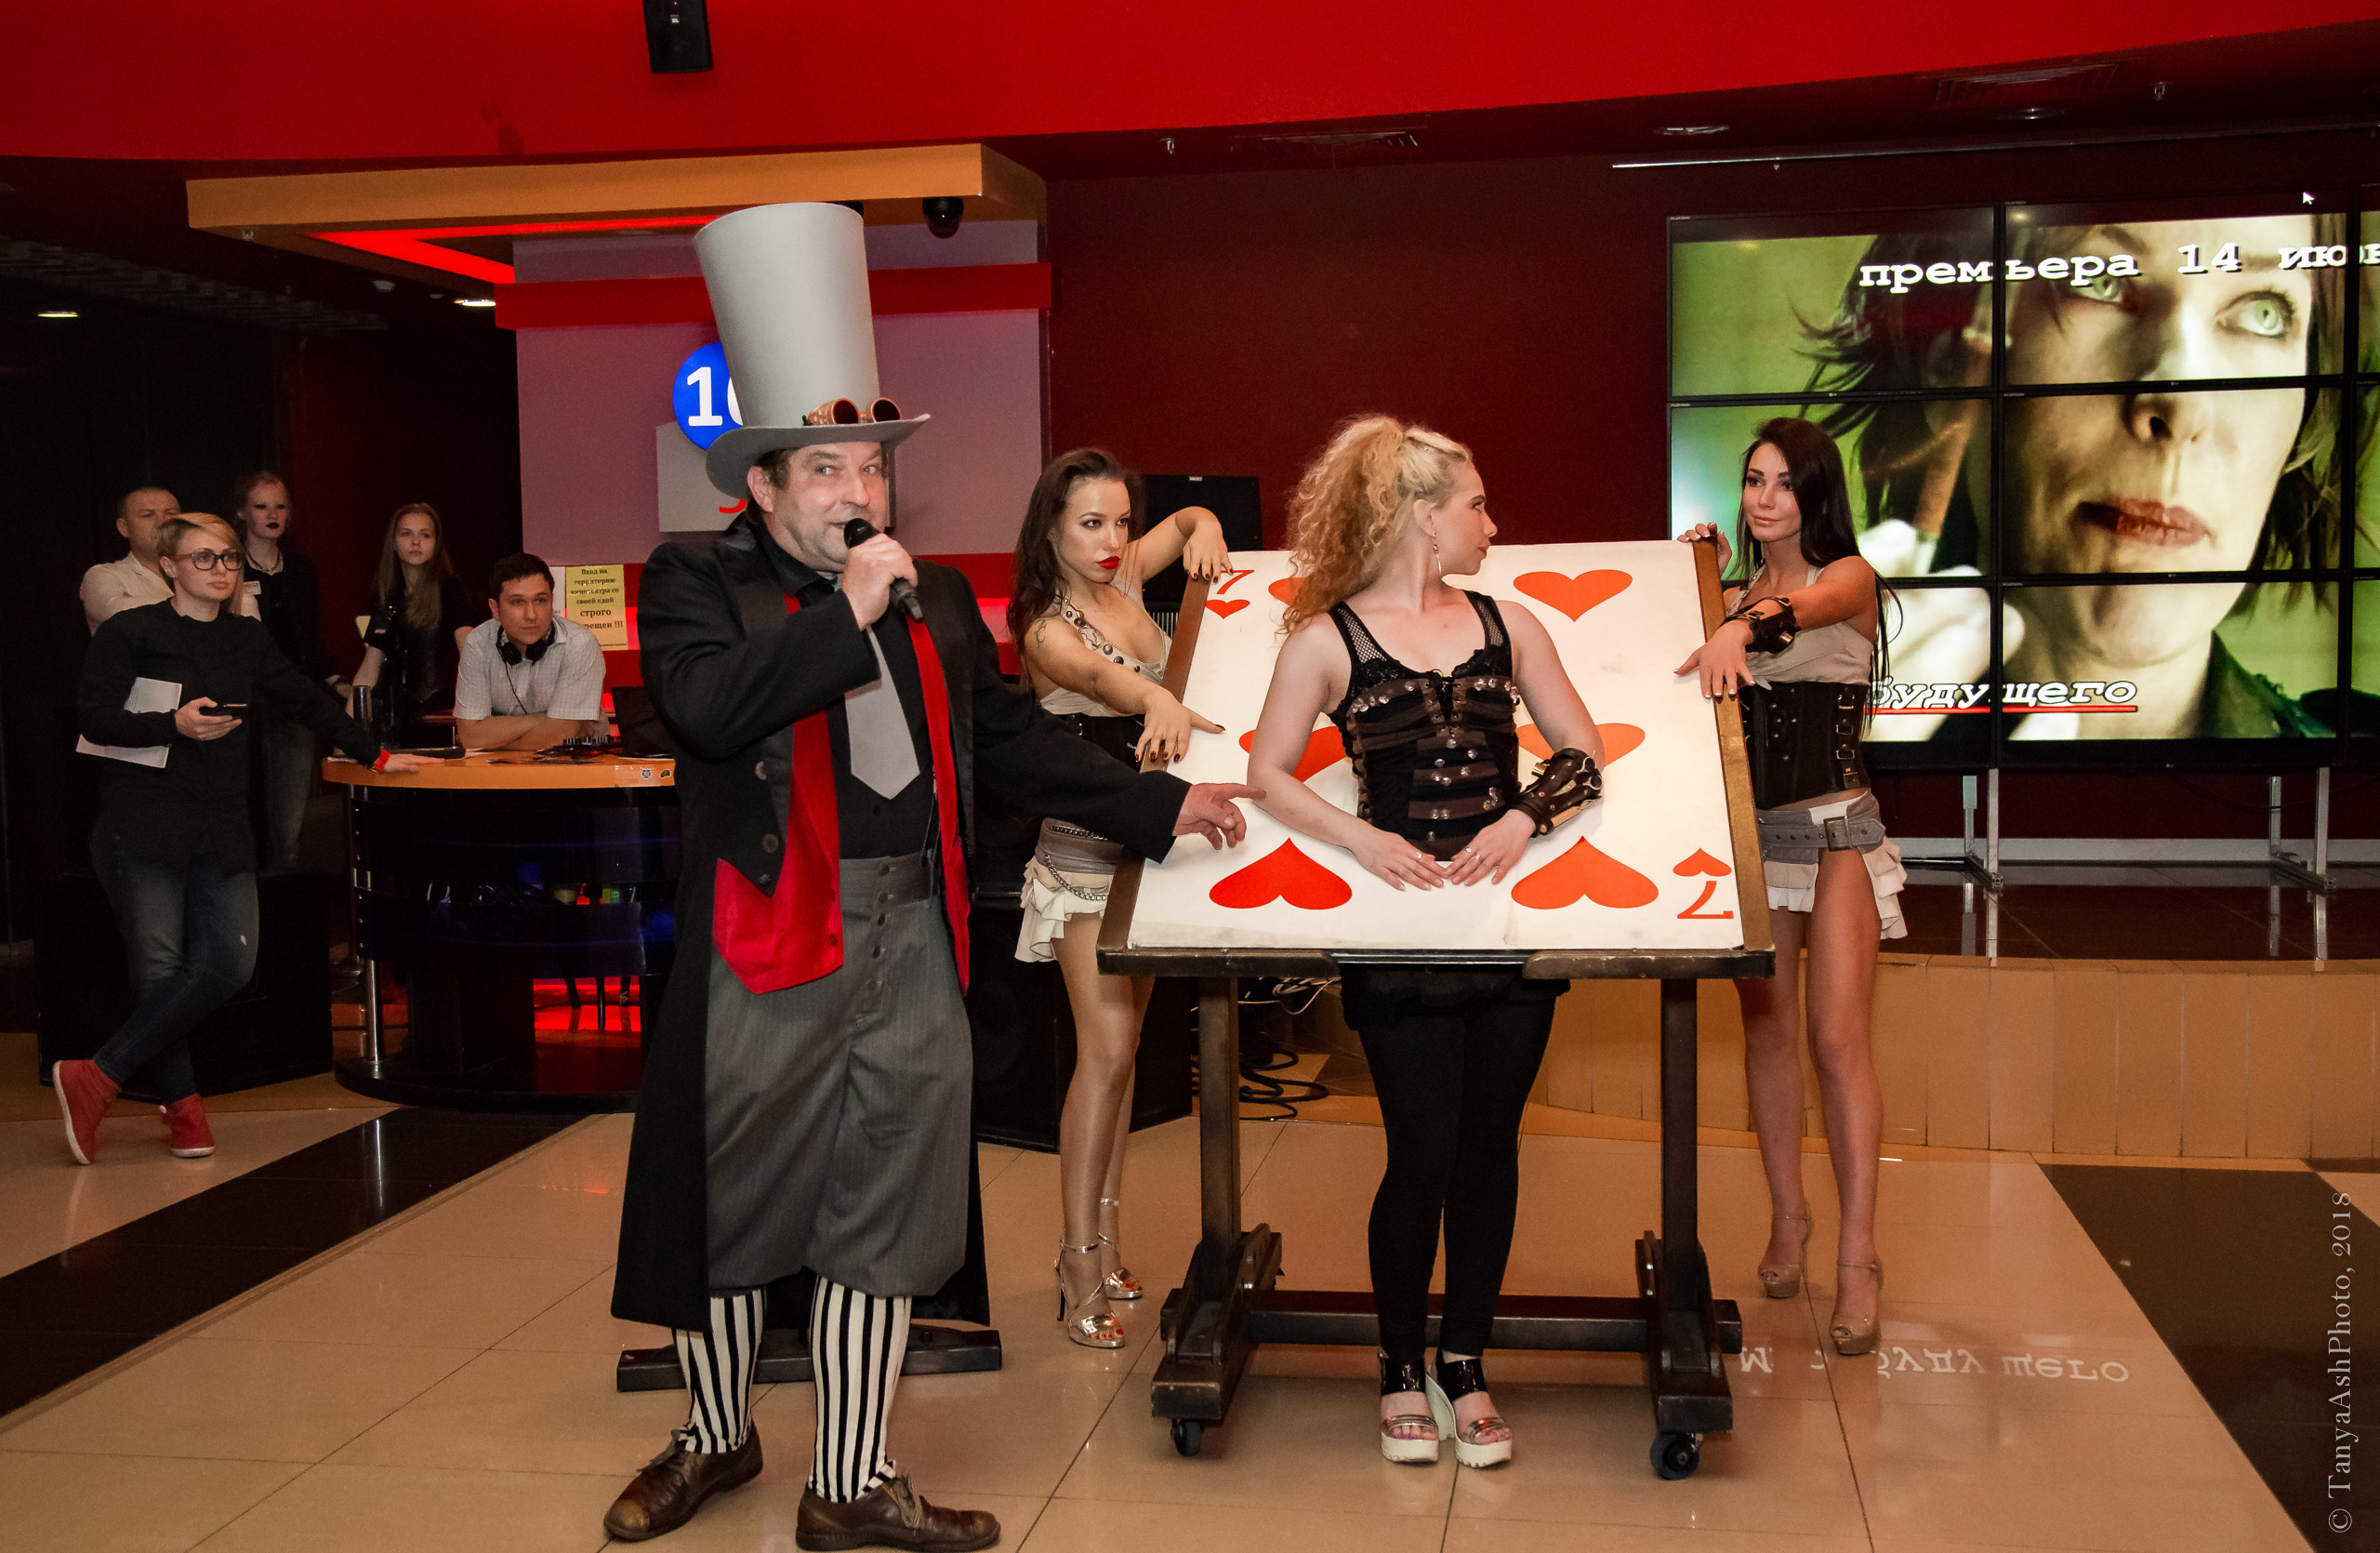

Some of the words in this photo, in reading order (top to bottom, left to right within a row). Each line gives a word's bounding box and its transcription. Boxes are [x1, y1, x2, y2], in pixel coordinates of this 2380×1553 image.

[1859, 254, 2139, 294] премьера
[2177, 242, 2241, 274] 14
[1216, 569, 1255, 594] 7
[580, 609, 612, 618] строго
[1677, 881, 1734, 919] 7
